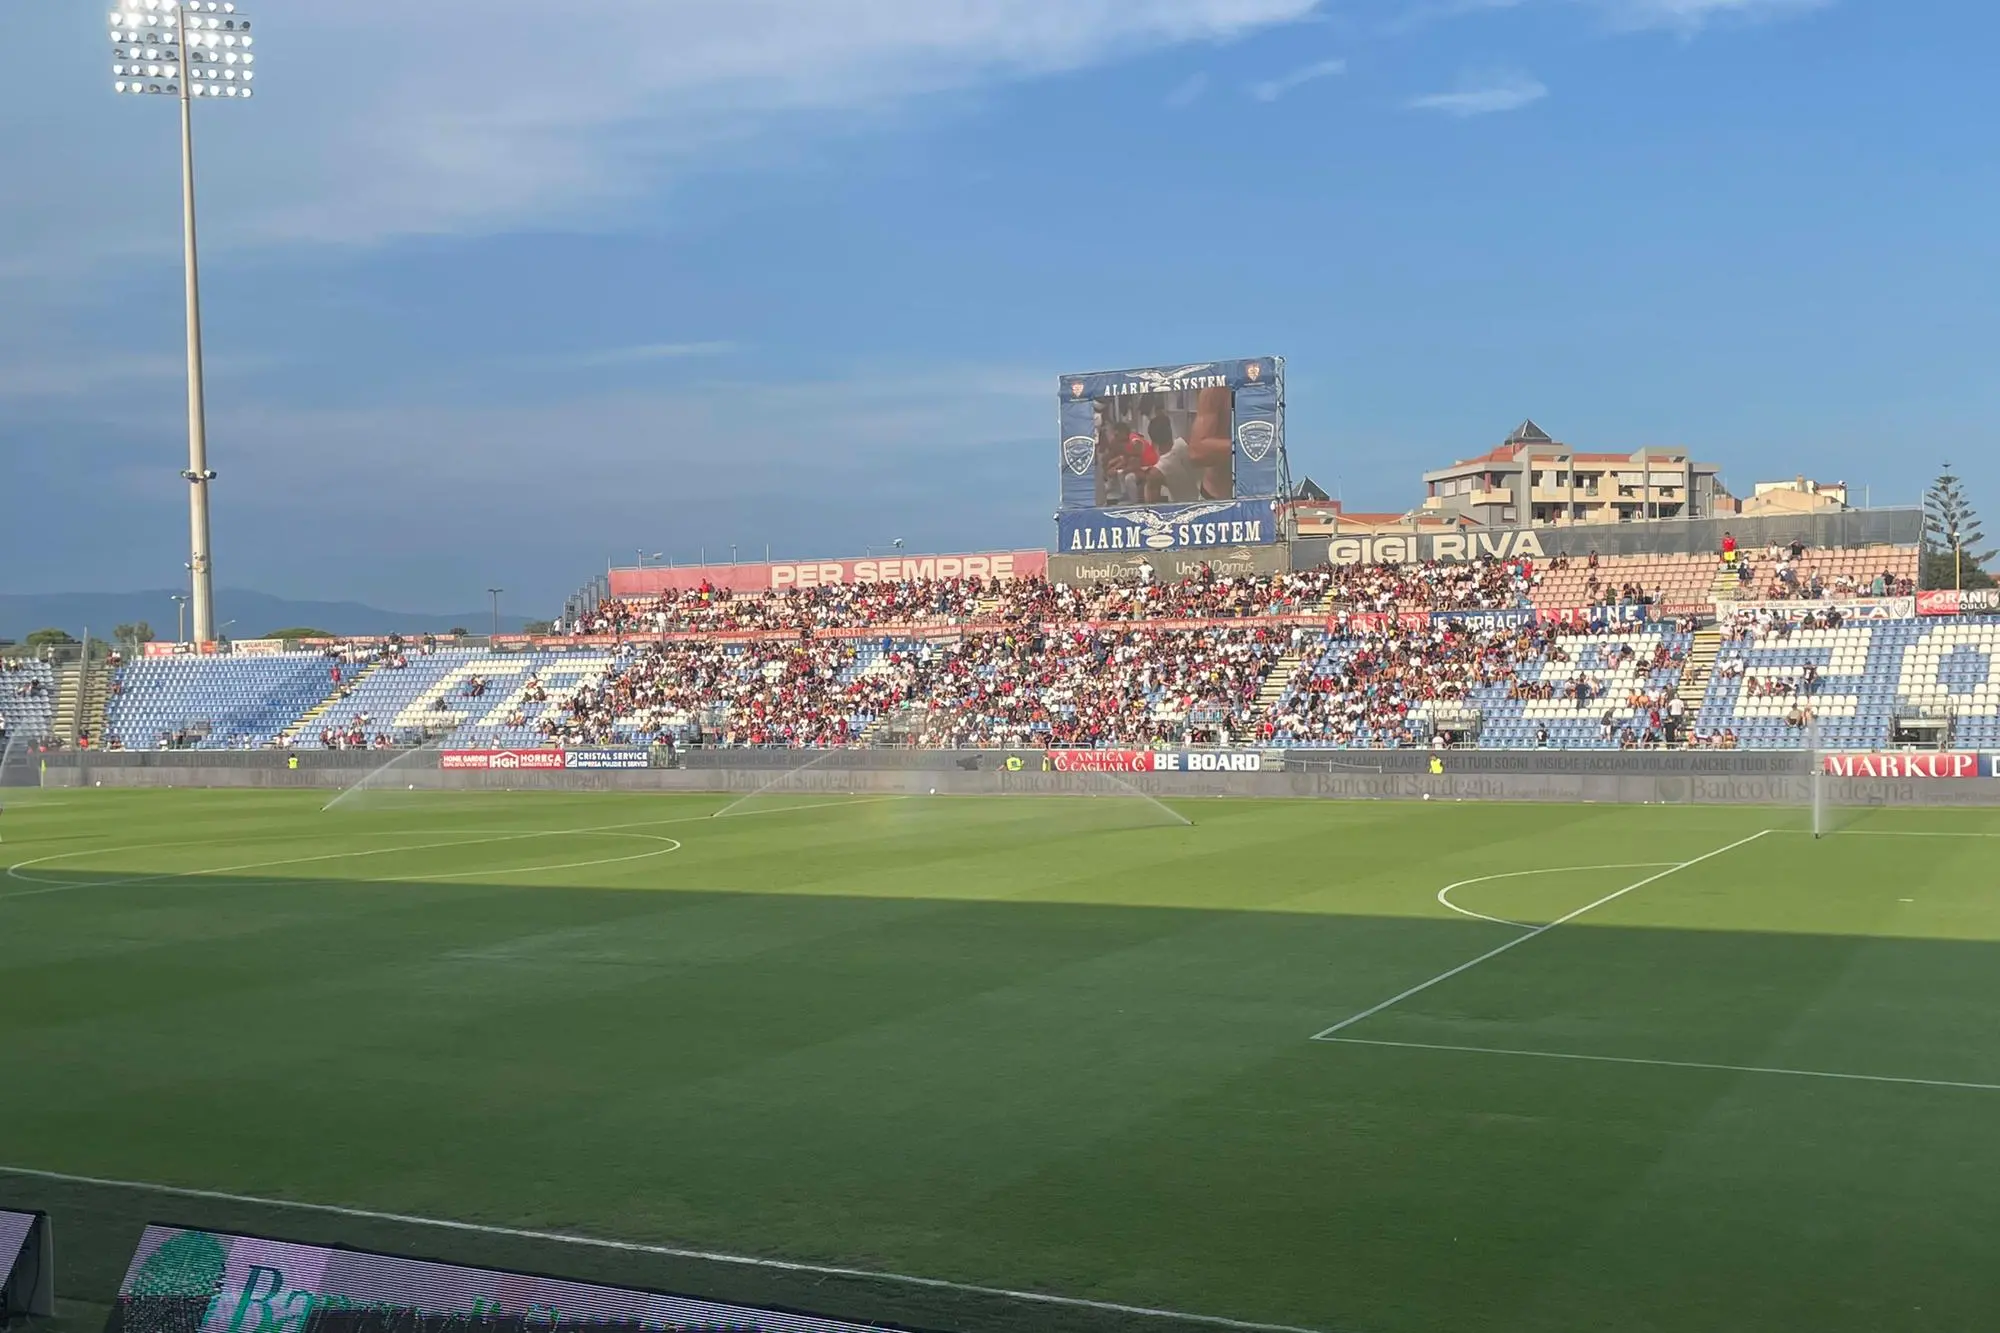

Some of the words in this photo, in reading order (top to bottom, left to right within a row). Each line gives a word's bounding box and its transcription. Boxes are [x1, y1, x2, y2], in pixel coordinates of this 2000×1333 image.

[1104, 380, 1150, 397] ALARM
[1173, 375, 1226, 392] SYSTEM
[1071, 526, 1141, 550] ALARM
[1179, 520, 1261, 546] SYSTEM
[1328, 536, 1418, 564] GIGI
[1432, 531, 1545, 560] RIVA
[771, 564, 844, 588] PER
[853, 554, 1014, 584] SEMPRE
[1076, 564, 1140, 581] UnipolDom
[1932, 591, 1987, 604] ORANI
[492, 757, 519, 768] HGH
[520, 754, 562, 762] HORECA
[578, 752, 611, 760] CRISTAL
[613, 752, 648, 760] SERVICE
[1075, 752, 1125, 761] ANTICA
[1154, 753, 1180, 770] BE
[1187, 753, 1260, 771] BOARD
[1381, 757, 1421, 769] VOLARE
[1424, 757, 1461, 769] AHE
[1494, 757, 1528, 770] SOGNI
[1535, 757, 1581, 770] INSIEME
[1583, 757, 1639, 770] FACCIAMO
[1690, 758, 1731, 771] ANCHE
[1070, 762, 1129, 772] CAGLIARI
[1829, 755, 1973, 777] MARKUP
[1317, 775, 1379, 794] Banco
[1404, 774, 1504, 798] Sardegna
[1690, 777, 1764, 799] Banco
[1769, 777, 1789, 800] di
[1795, 776, 1914, 804] Srdegna
